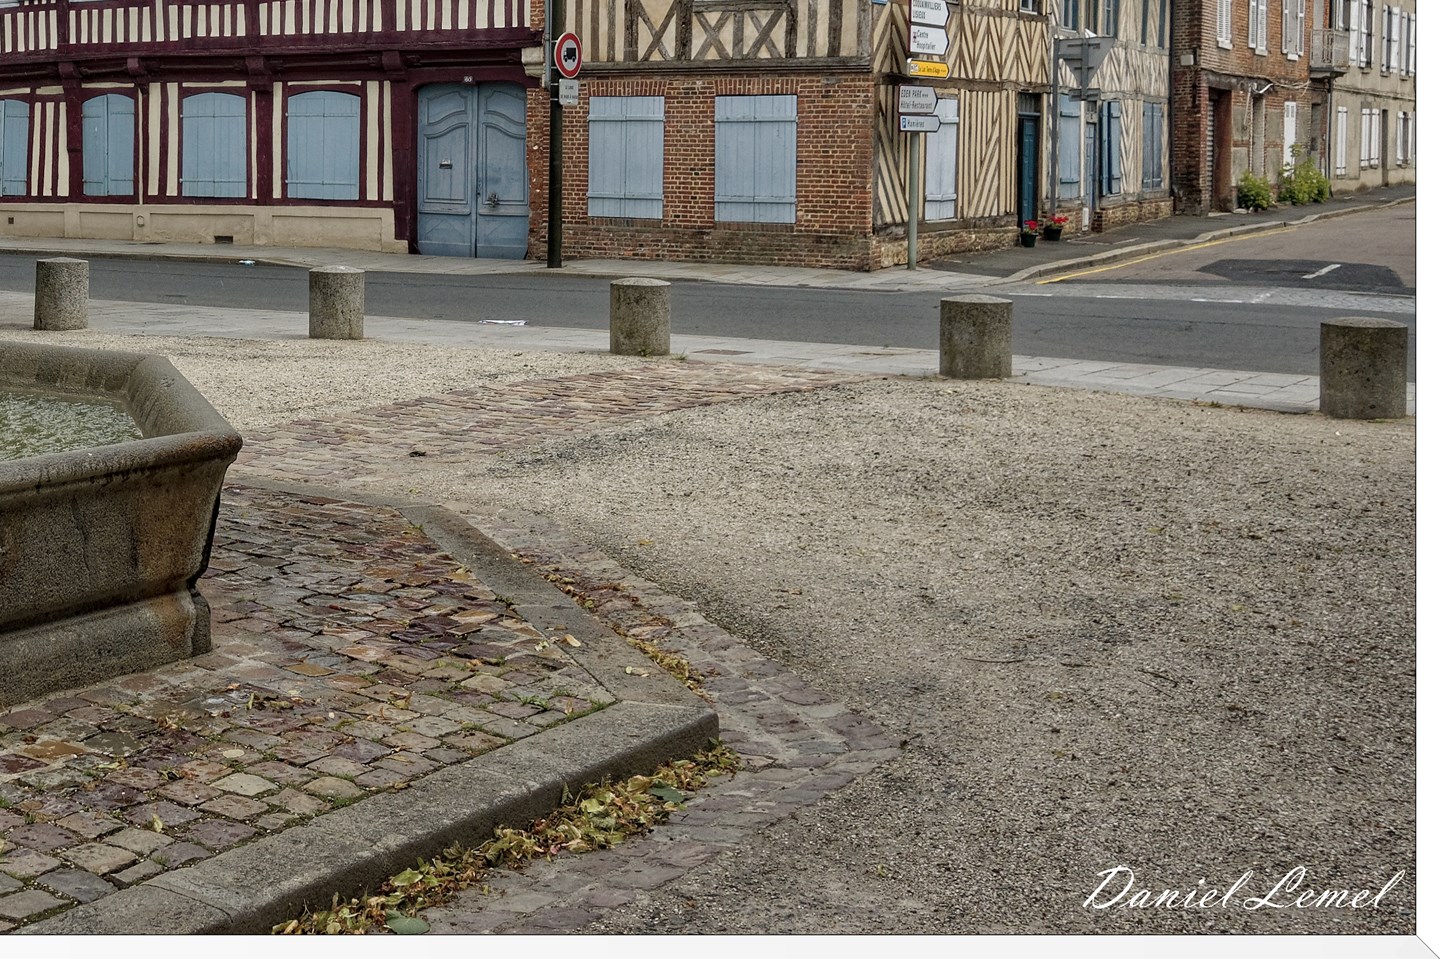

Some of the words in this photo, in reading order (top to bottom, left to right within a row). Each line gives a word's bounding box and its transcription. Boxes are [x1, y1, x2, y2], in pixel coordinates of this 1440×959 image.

[917, 29, 929, 39] Centre
[901, 89, 911, 98] EDEN
[912, 89, 922, 98] PARK
